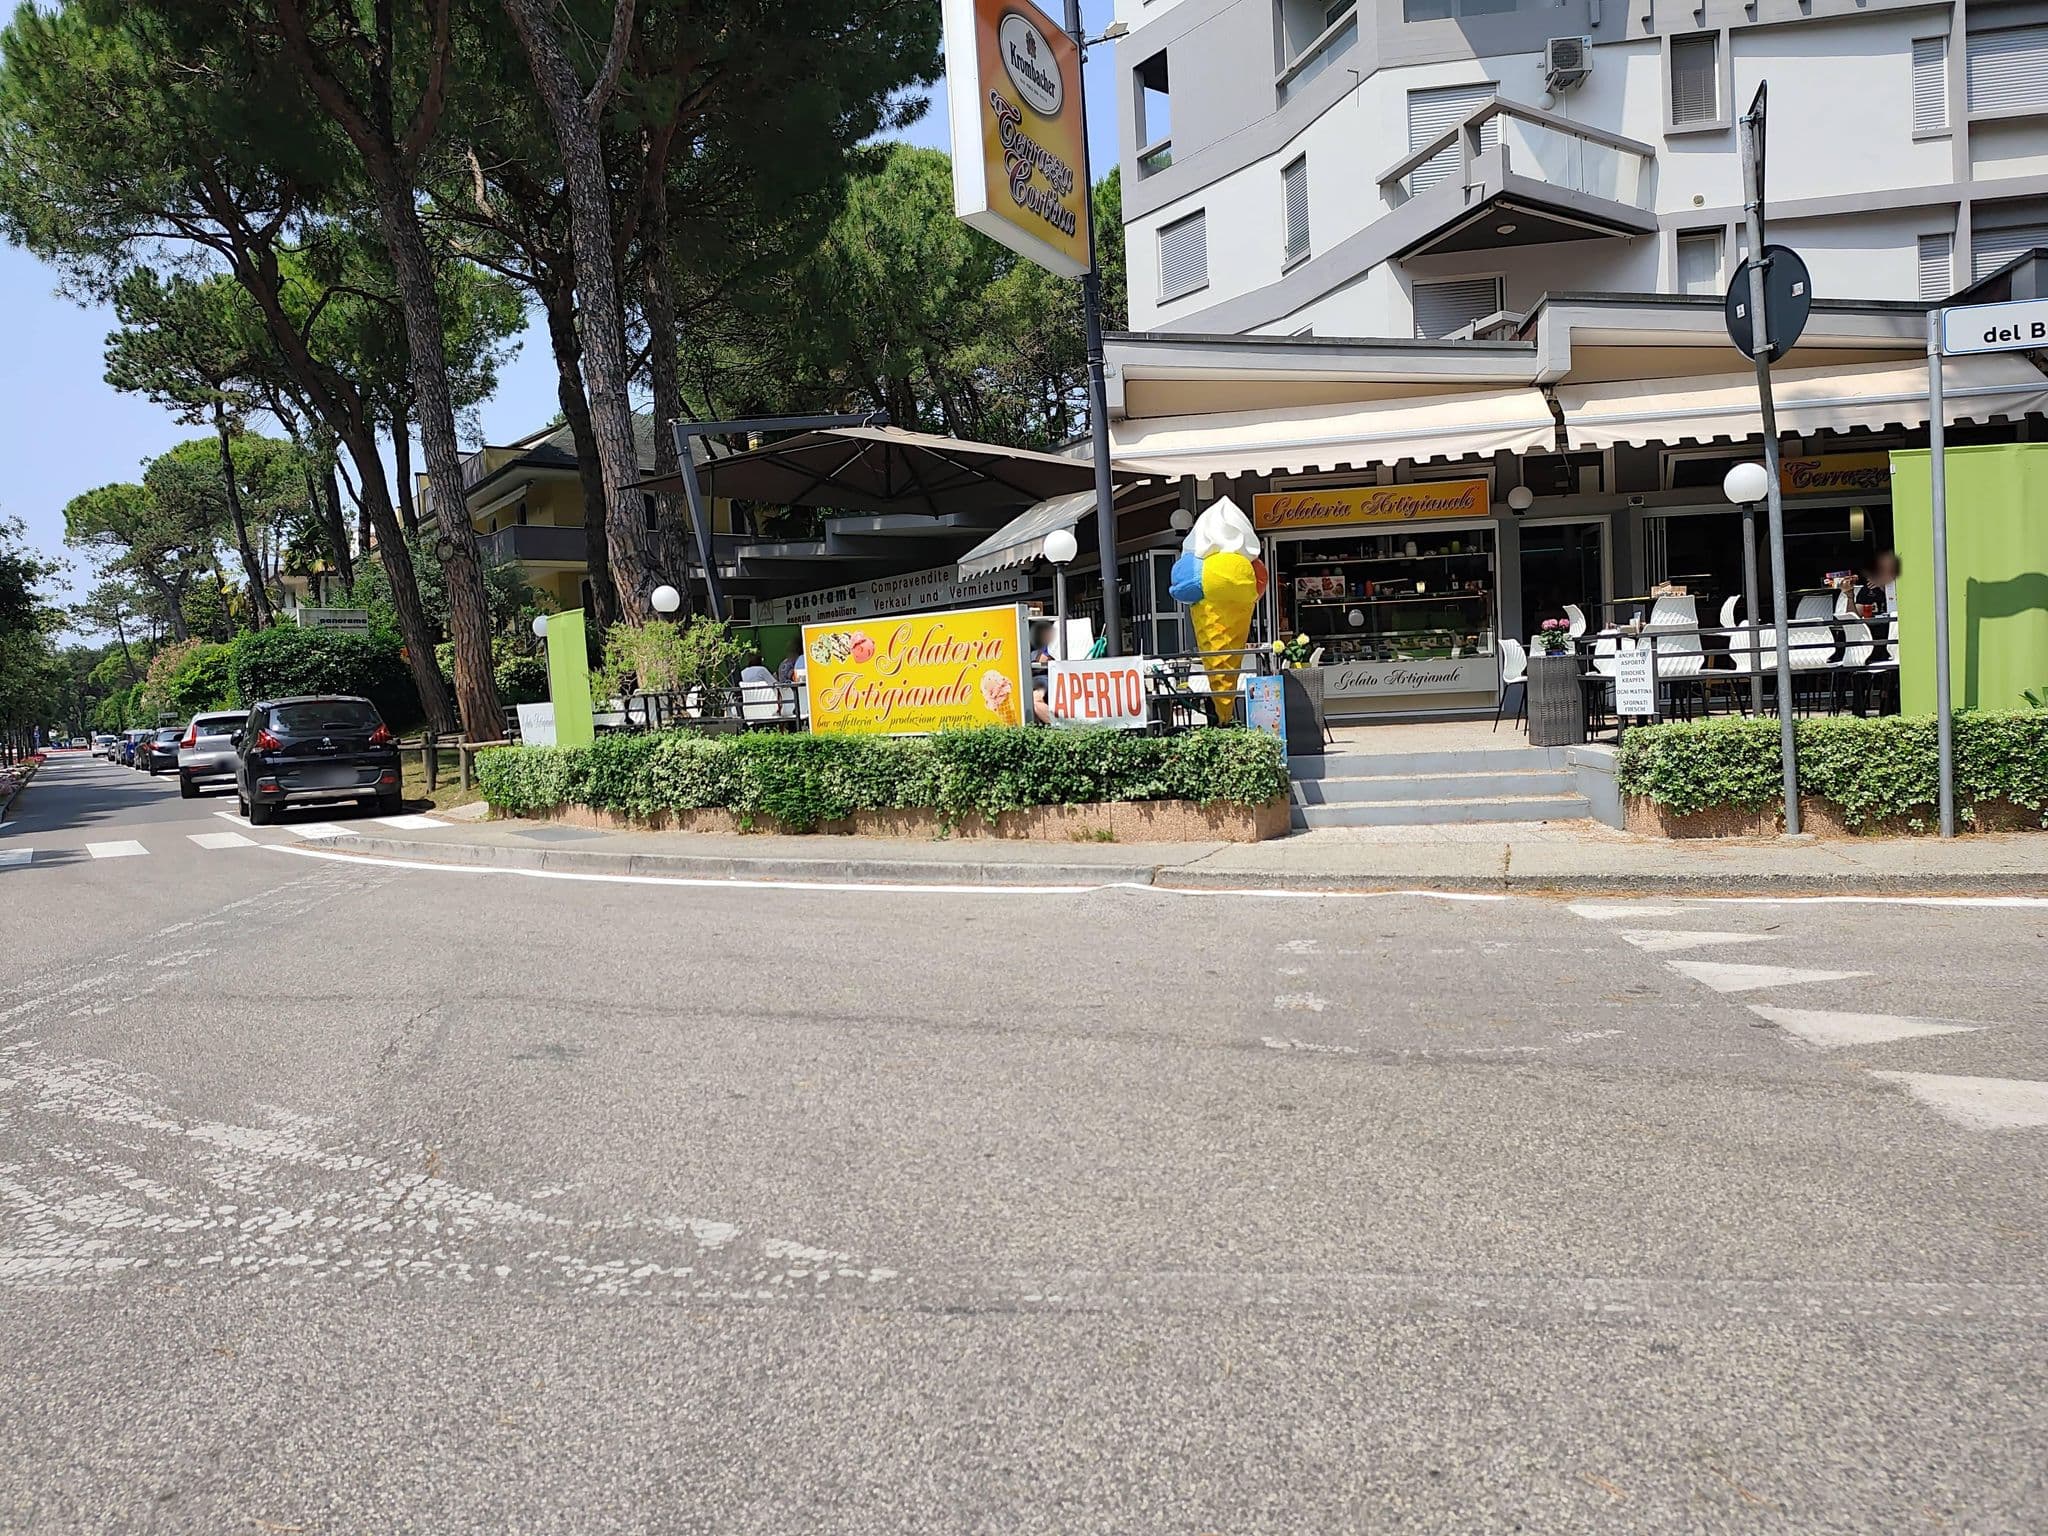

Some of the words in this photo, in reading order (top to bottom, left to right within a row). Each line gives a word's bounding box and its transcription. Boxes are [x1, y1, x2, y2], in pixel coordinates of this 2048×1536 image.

[1009, 41, 1056, 99] Krombacher
[990, 88, 1074, 195] Terrazza
[1004, 148, 1076, 237] Cortina
[1983, 324, 2021, 343] del
[1263, 495, 1353, 525] Gelateria
[1361, 486, 1479, 518] Artigianale
[786, 586, 856, 615] panorama
[870, 570, 950, 594] Compravendite
[873, 593, 913, 611] Verkauf
[920, 589, 939, 604] und
[950, 576, 1018, 598] Vermietung
[817, 606, 857, 620] immobiliare
[875, 622, 1004, 676] Gelateria
[818, 663, 978, 722] Artigianale
[1053, 669, 1142, 719] APERTO
[1334, 670, 1379, 690] Gelato
[1383, 666, 1463, 689] Artigianale
[817, 714, 830, 728] bar
[833, 714, 872, 730] caffetteria
[889, 711, 936, 729] produzione
[938, 710, 974, 728] propria
